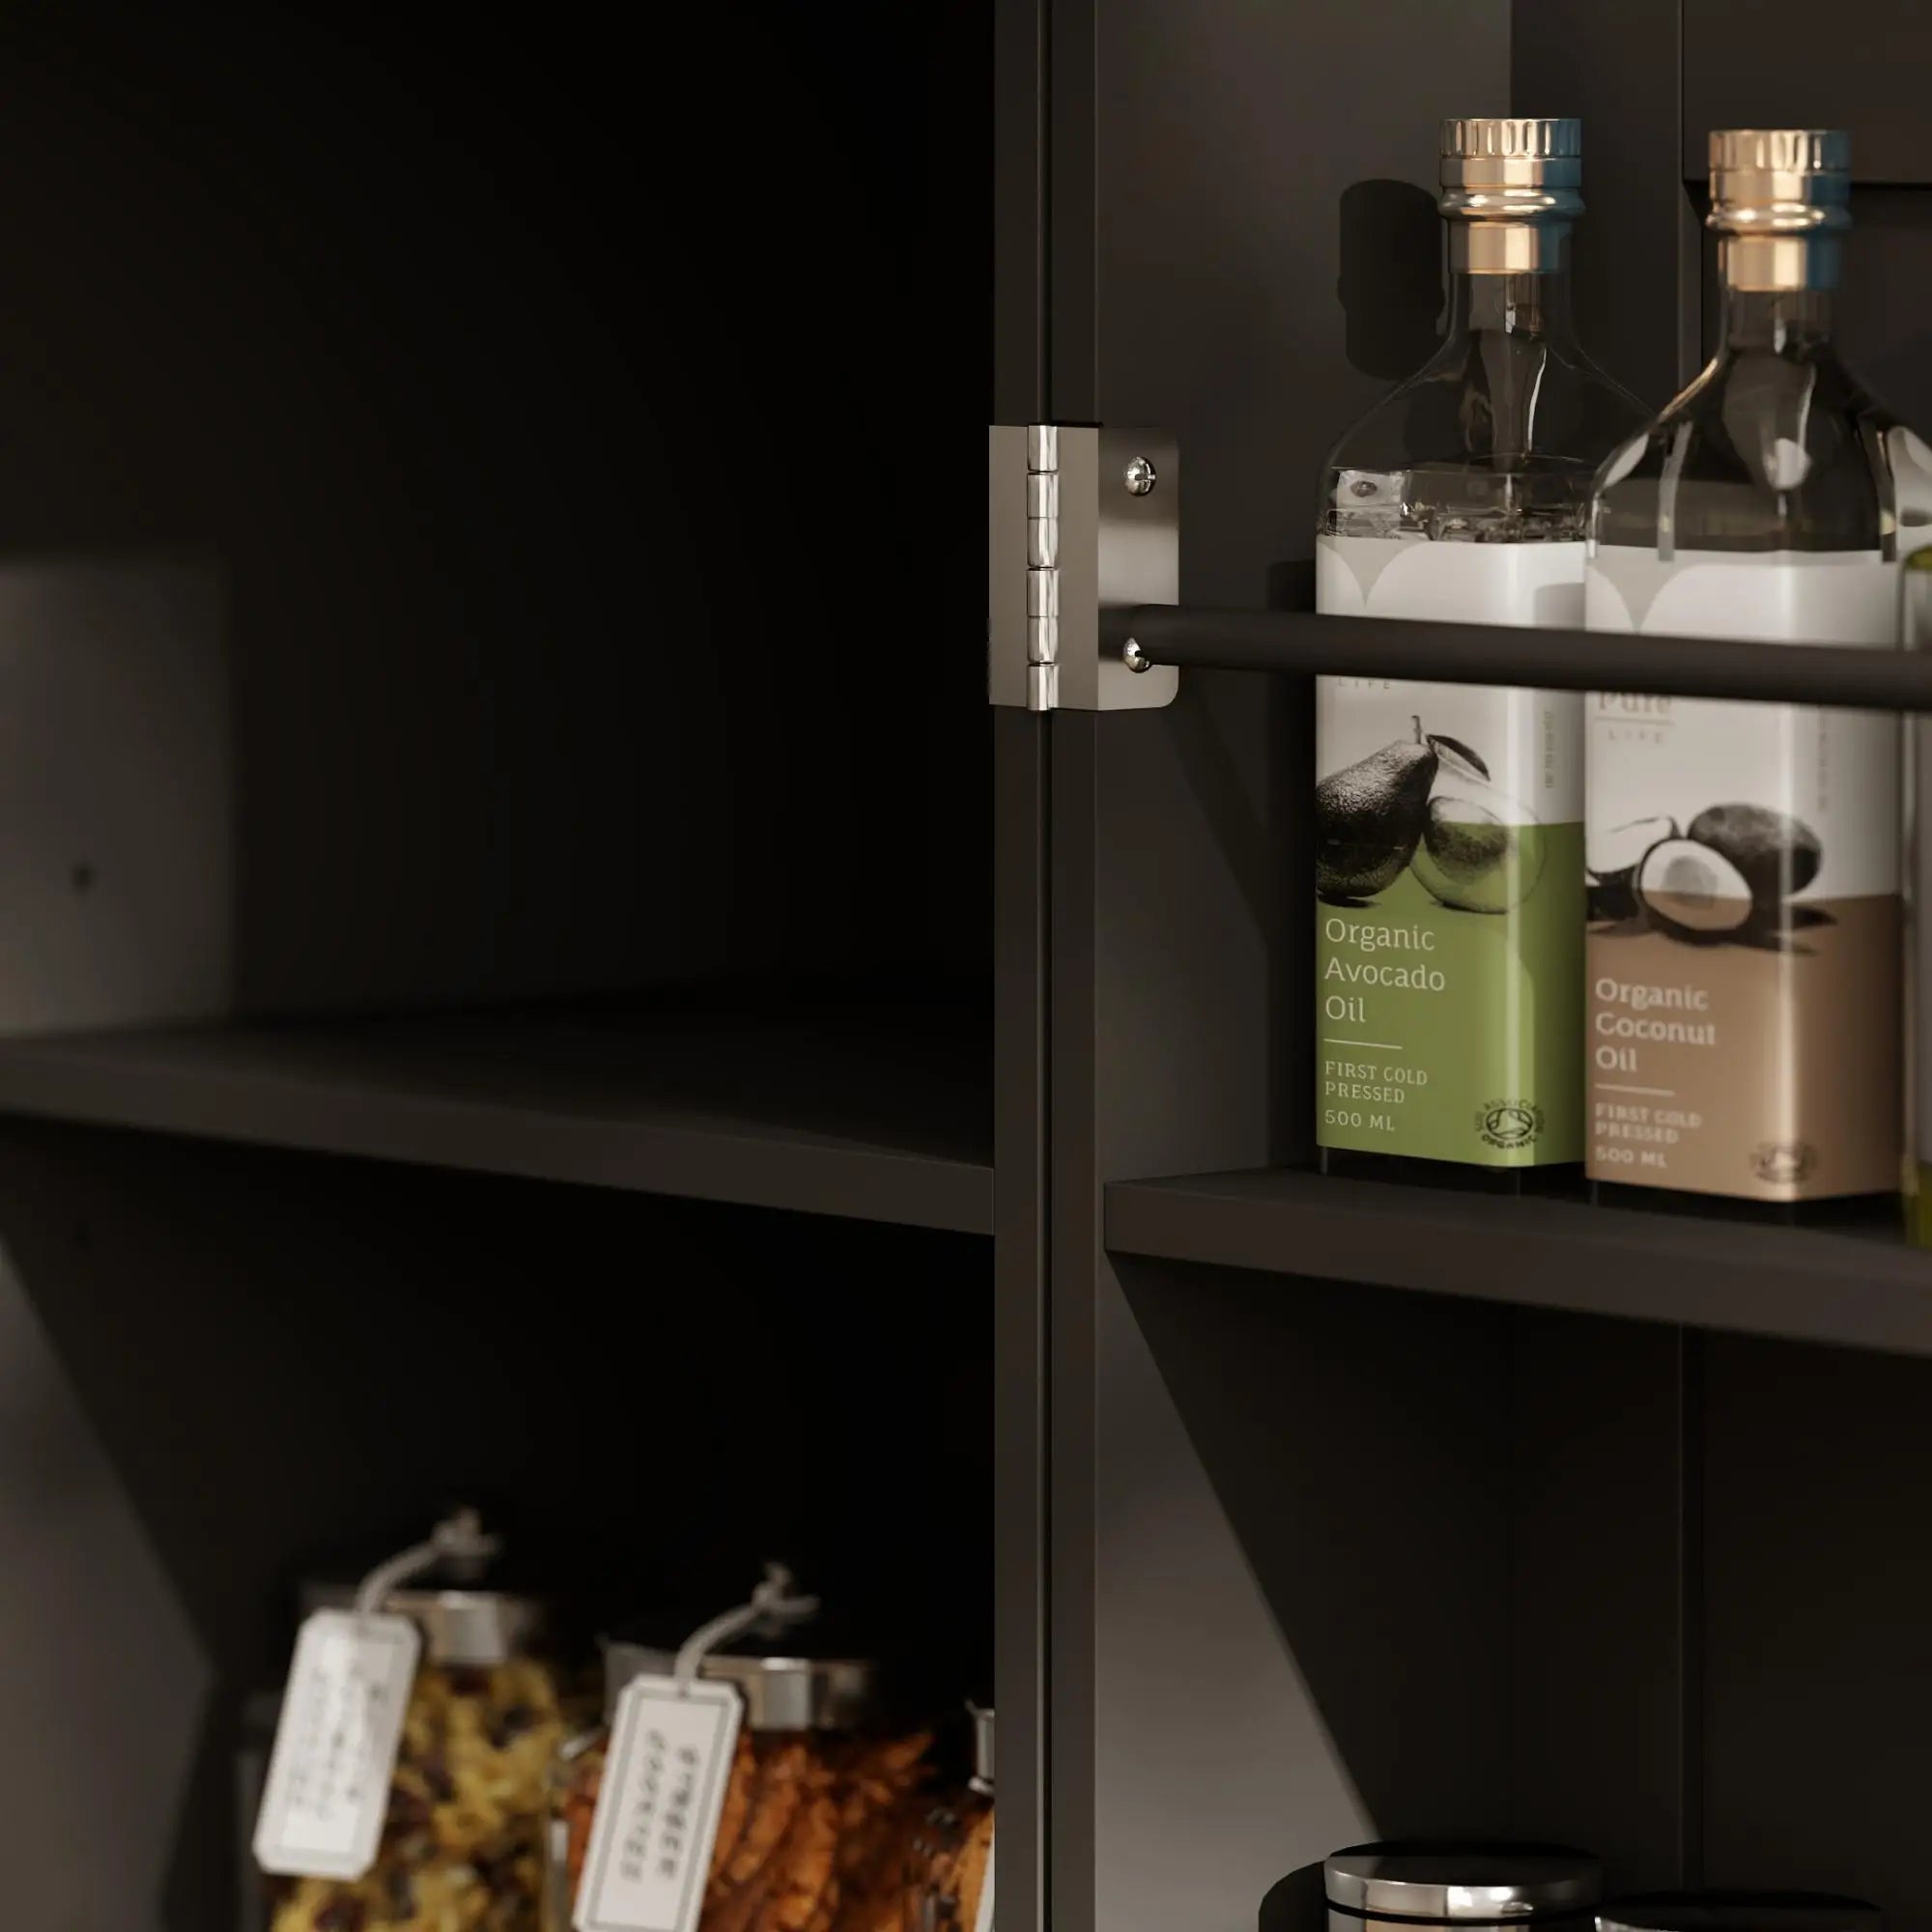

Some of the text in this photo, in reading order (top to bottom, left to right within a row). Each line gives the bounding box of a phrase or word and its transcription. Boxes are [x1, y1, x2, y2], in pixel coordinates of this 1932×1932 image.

[1338, 676, 1390, 690] LIFE
[1325, 918, 1435, 952] Organic
[1324, 956, 1445, 991] Avocado
[1595, 978, 1710, 1011] Organic
[1325, 995, 1366, 1022] Oil
[1595, 1012, 1717, 1045] Coconut
[1595, 1045, 1637, 1072] Oil
[1324, 1061, 1428, 1086] FIRST COLD
[1324, 1081, 1406, 1103] PRESSED
[1324, 1109, 1395, 1132] 500 ML
[1595, 1102, 1649, 1123] FIRST
[1595, 1120, 1679, 1145] PRESSED
[1595, 1146, 1667, 1168] 500 ML
